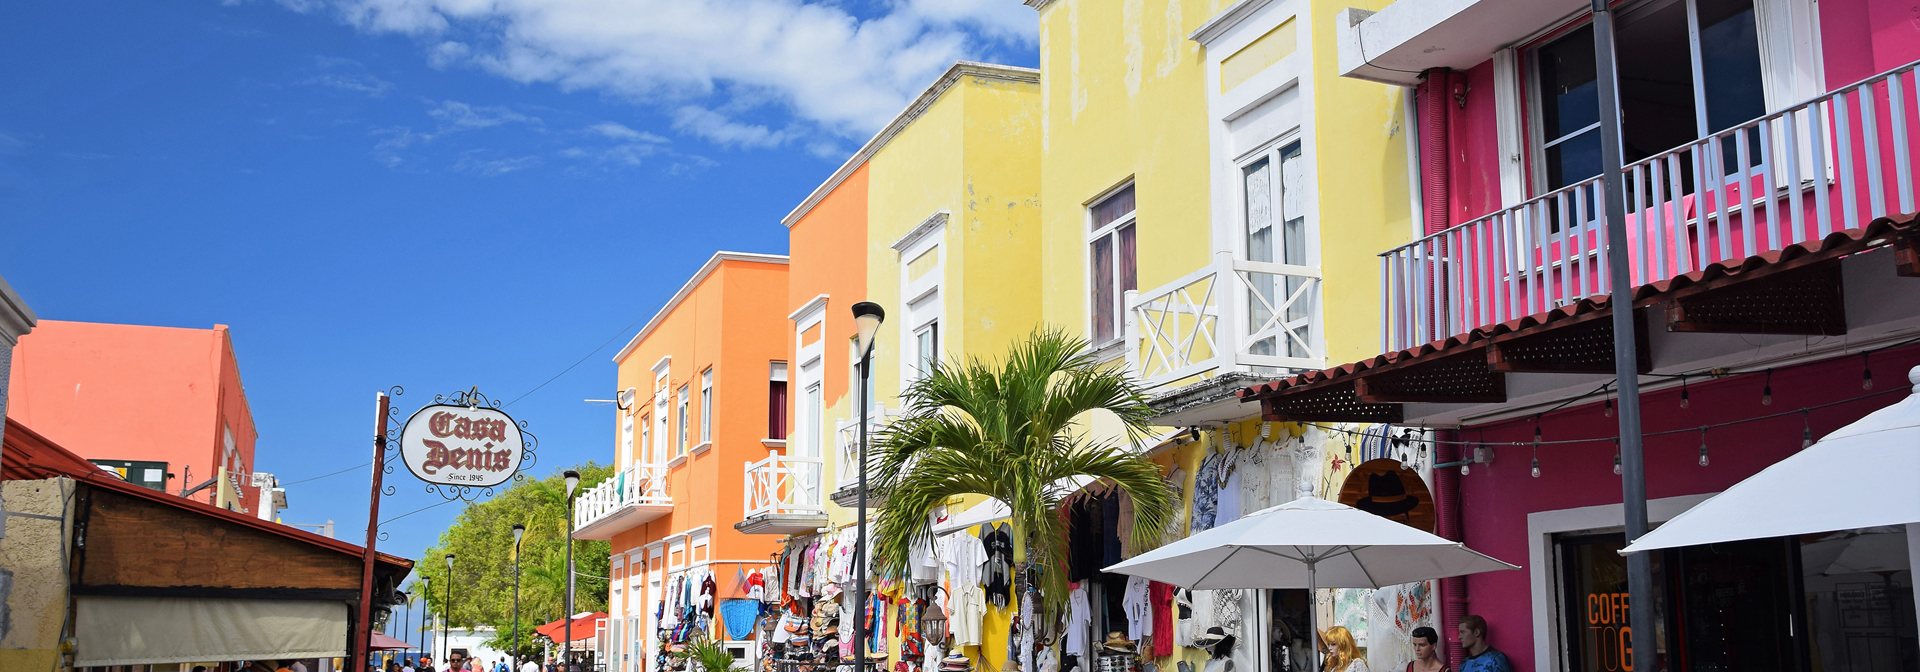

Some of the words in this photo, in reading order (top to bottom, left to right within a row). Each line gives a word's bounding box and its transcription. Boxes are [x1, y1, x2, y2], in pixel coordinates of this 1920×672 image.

[429, 411, 507, 443] Casa
[422, 438, 512, 475] Denis
[446, 473, 466, 481] Since
[469, 474, 484, 482] 1945
[1588, 593, 1630, 624] COFF
